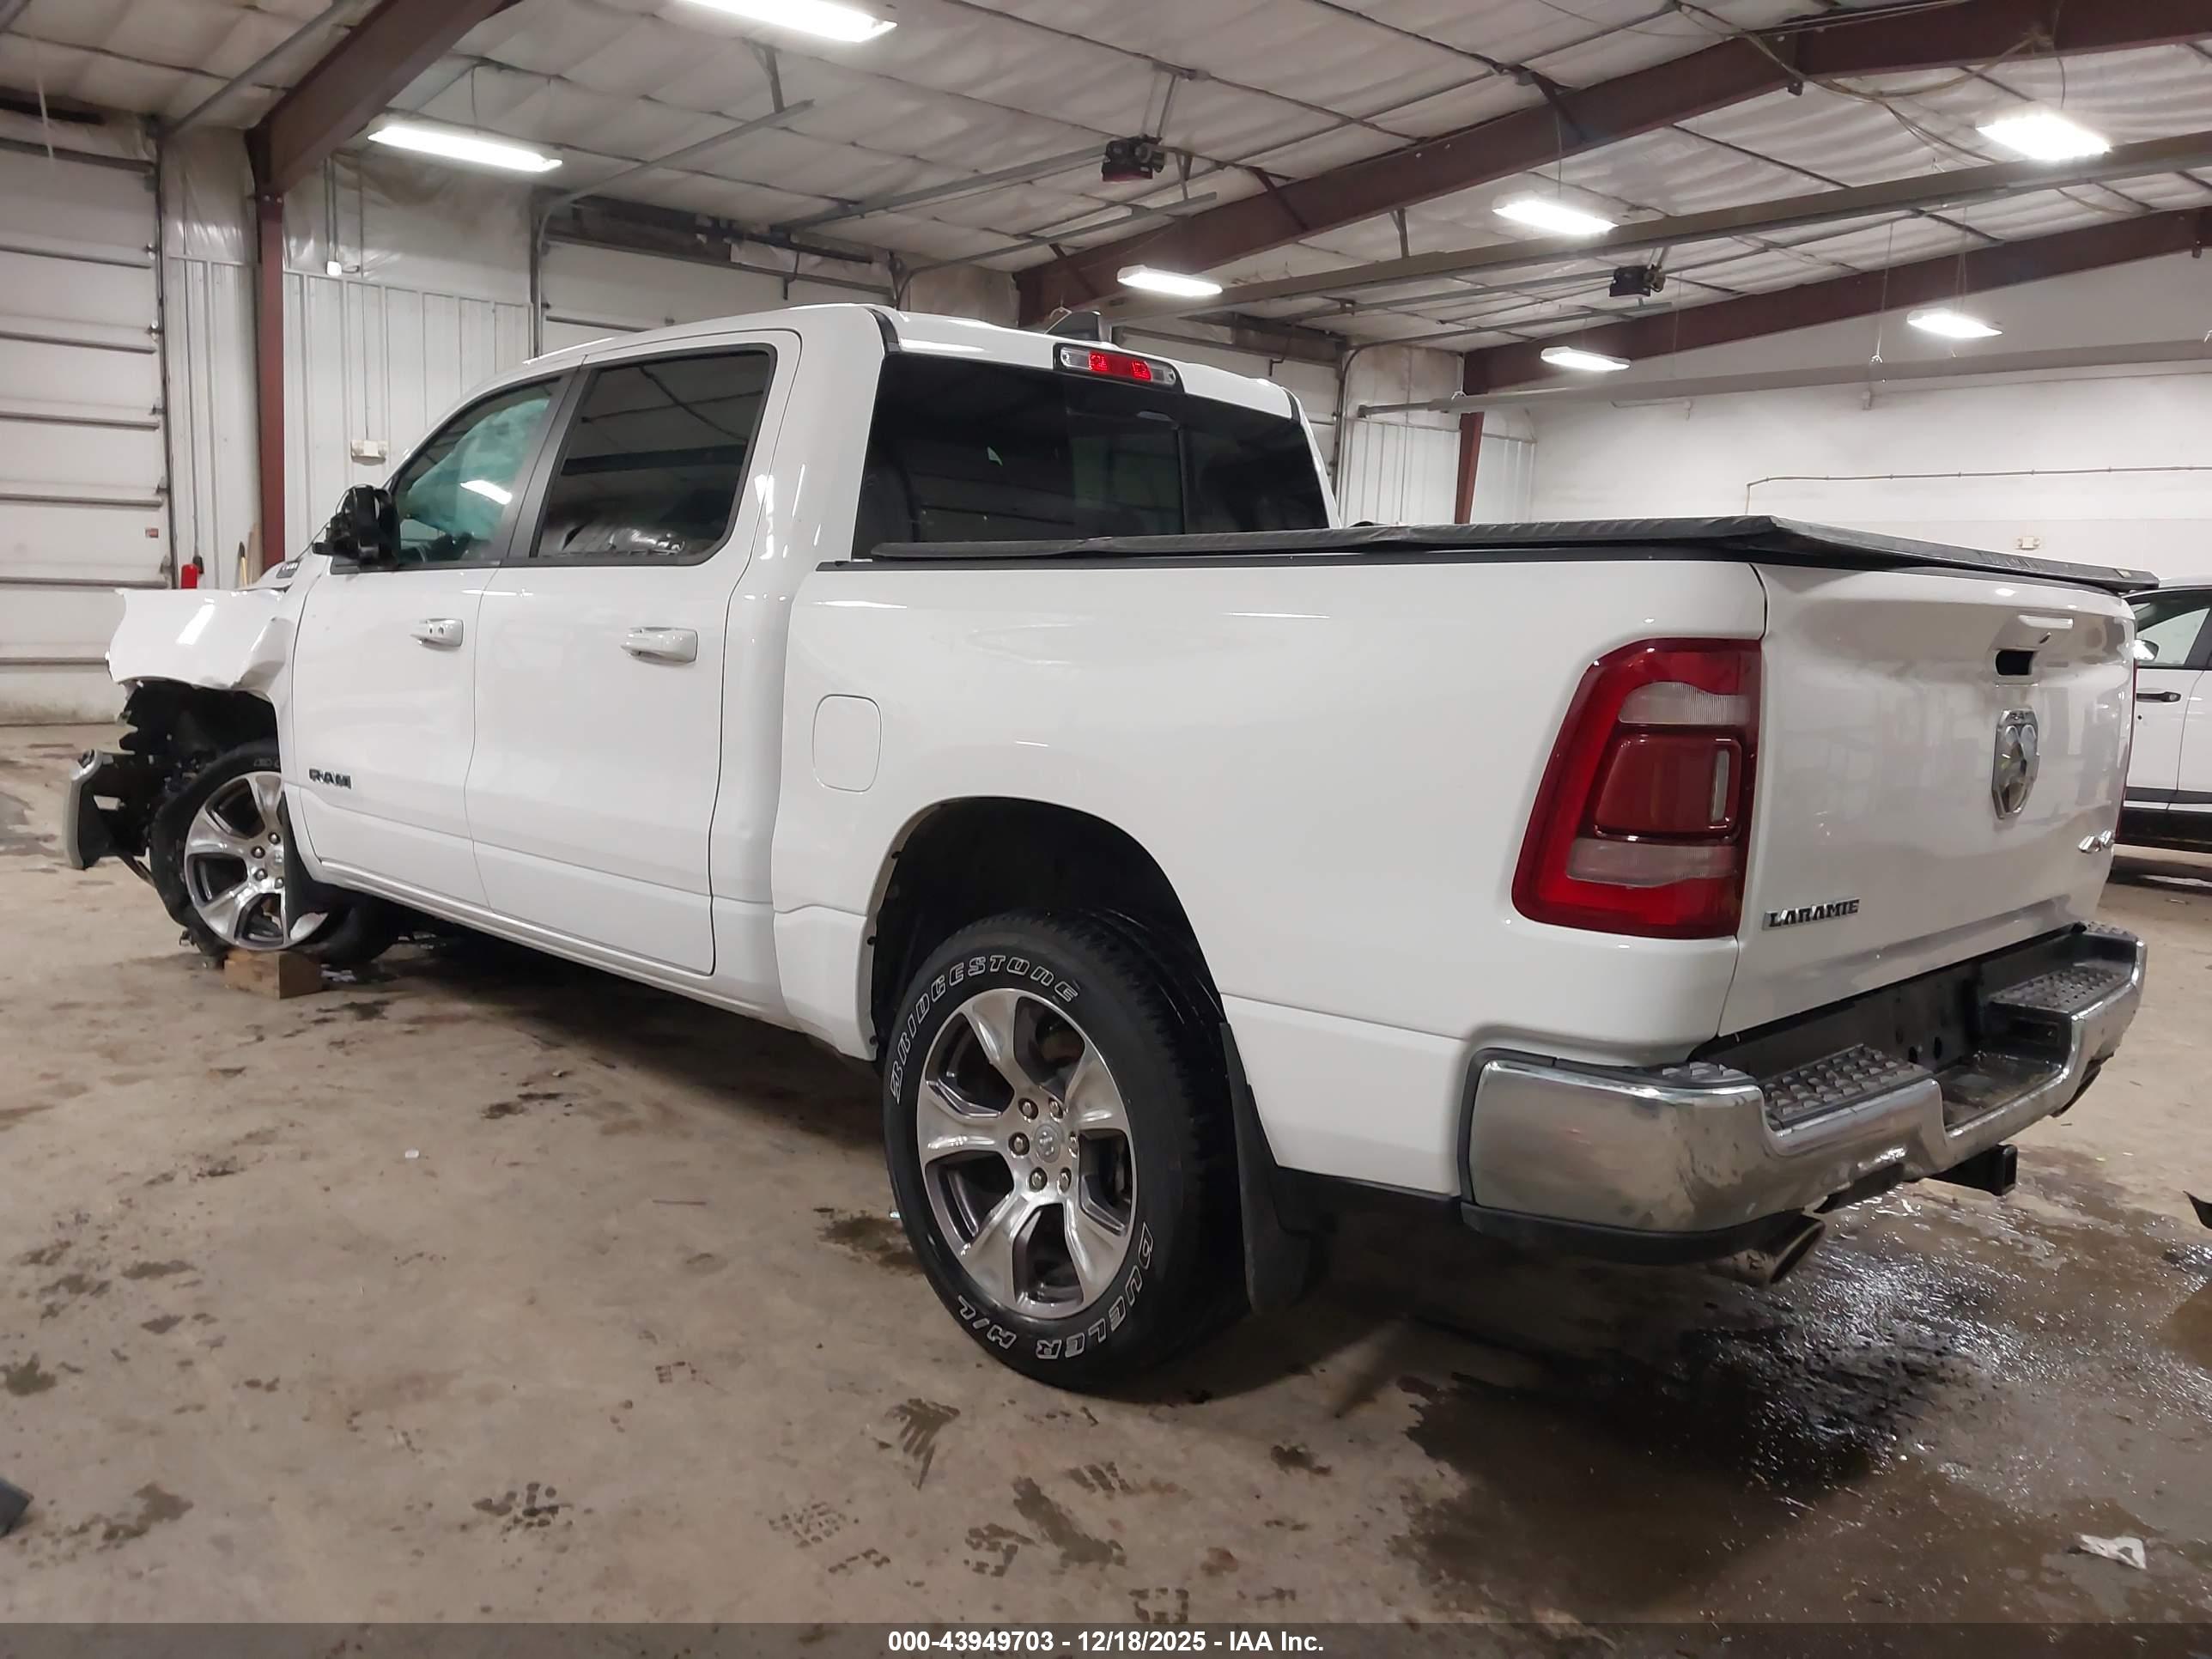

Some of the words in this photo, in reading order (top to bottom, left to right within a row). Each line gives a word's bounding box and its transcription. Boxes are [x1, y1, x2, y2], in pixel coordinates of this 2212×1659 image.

[309, 769, 352, 790] RAM
[1766, 898, 1860, 928] LARAMIE
[890, 955, 1079, 1105] BRIDGESTONE
[1036, 1222, 1153, 1359] DUELER
[957, 1295, 1017, 1349] H/L
